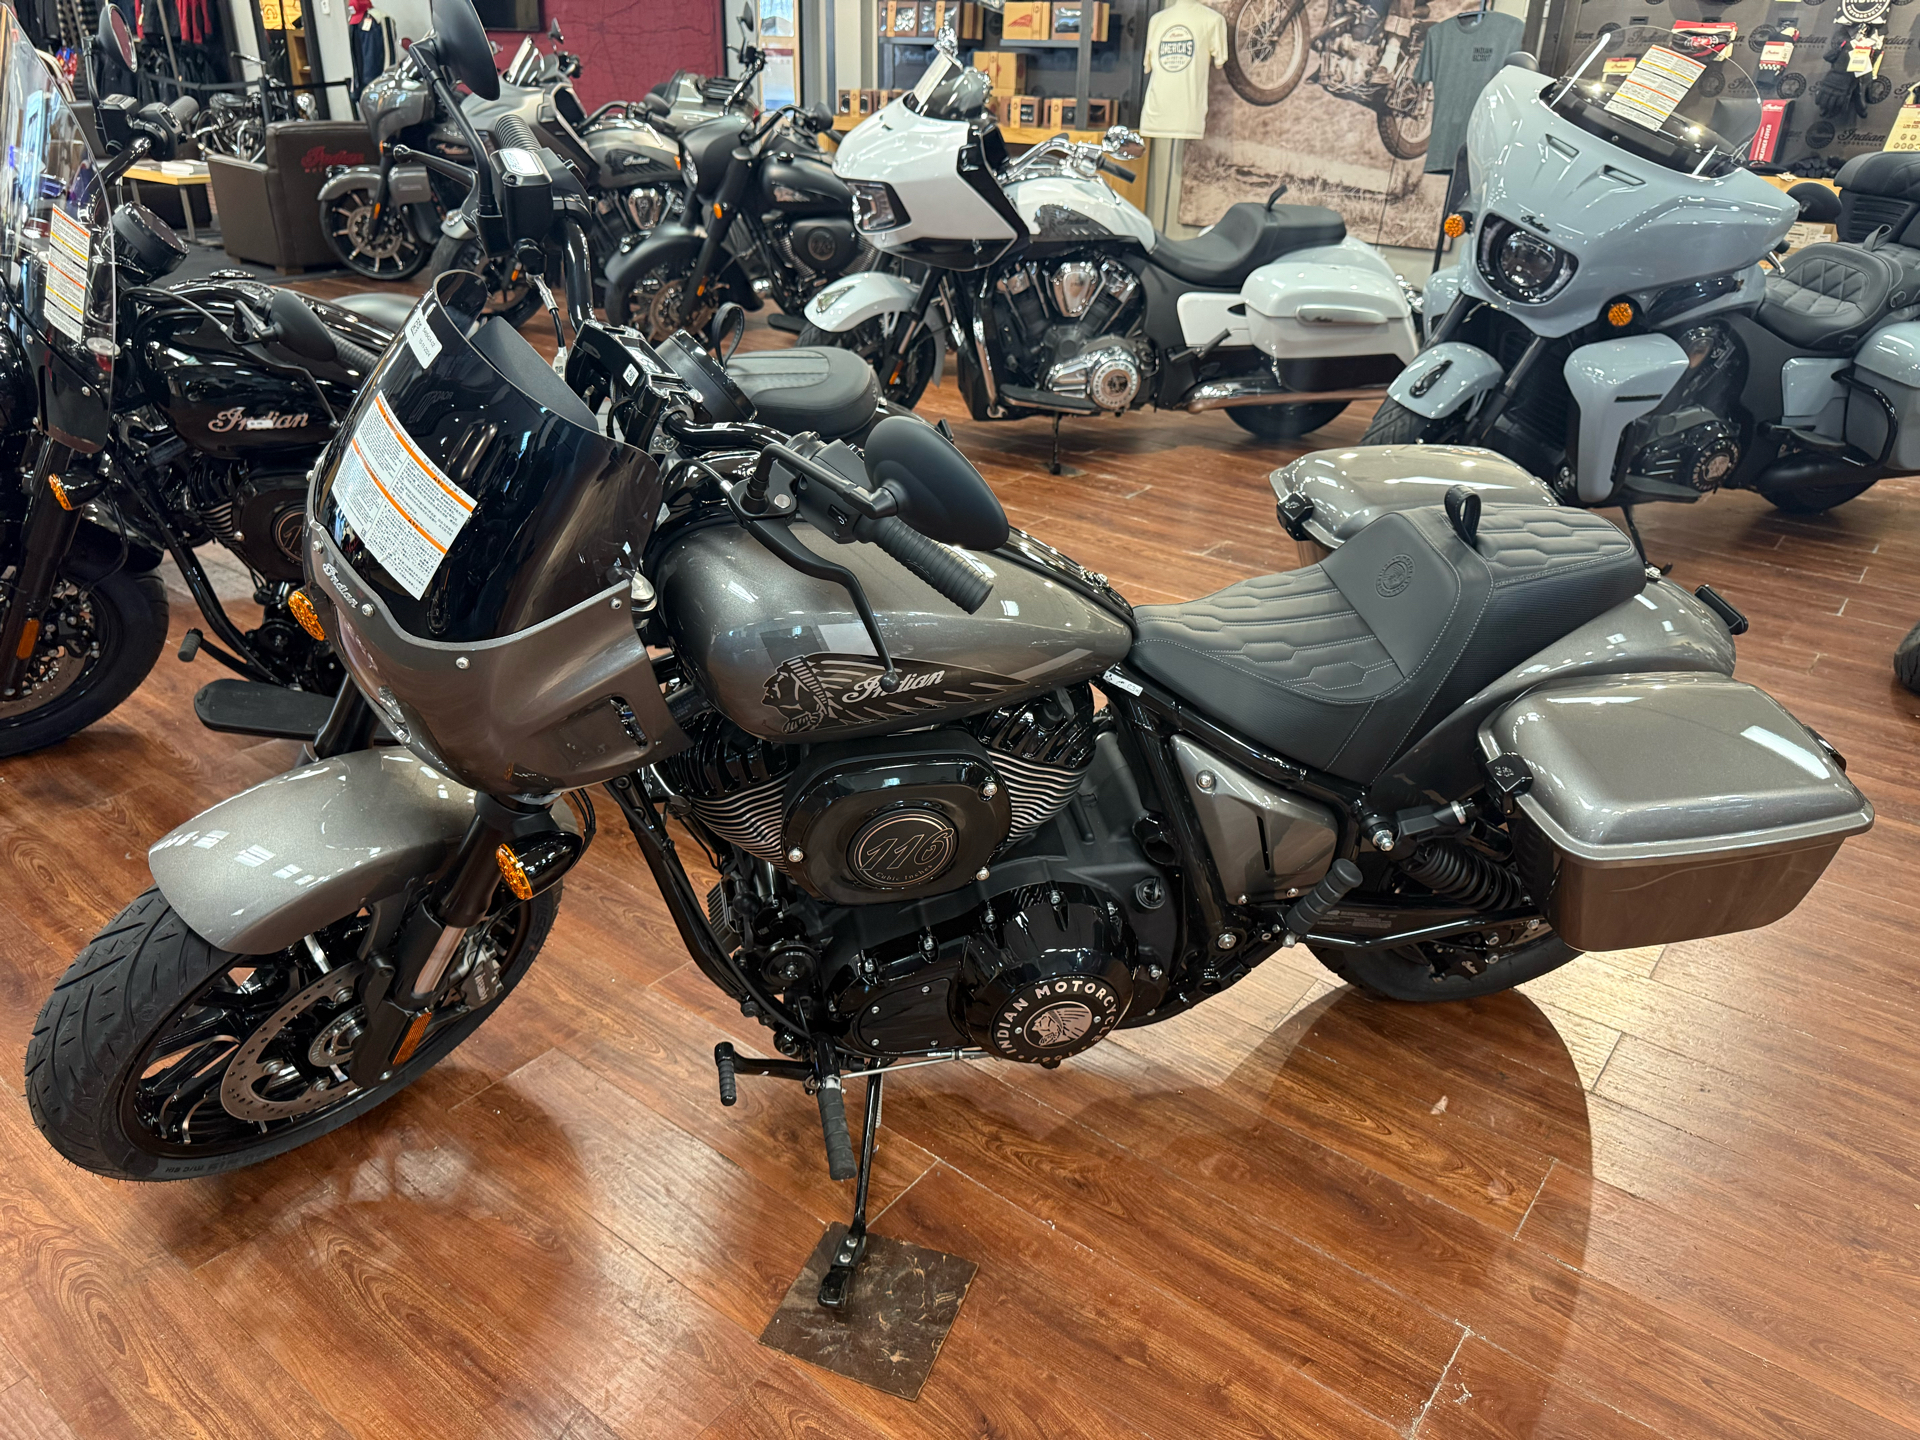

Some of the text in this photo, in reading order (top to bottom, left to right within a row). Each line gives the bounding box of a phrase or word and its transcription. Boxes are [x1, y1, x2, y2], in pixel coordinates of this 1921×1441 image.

[1837, 128, 1886, 142] Indian
[322, 563, 359, 608] Indian
[860, 828, 955, 870] 116
[875, 871, 899, 881] Cubic
[905, 864, 933, 880] Inches
[997, 980, 1117, 1054] INDIAN MOTORCYCLE
